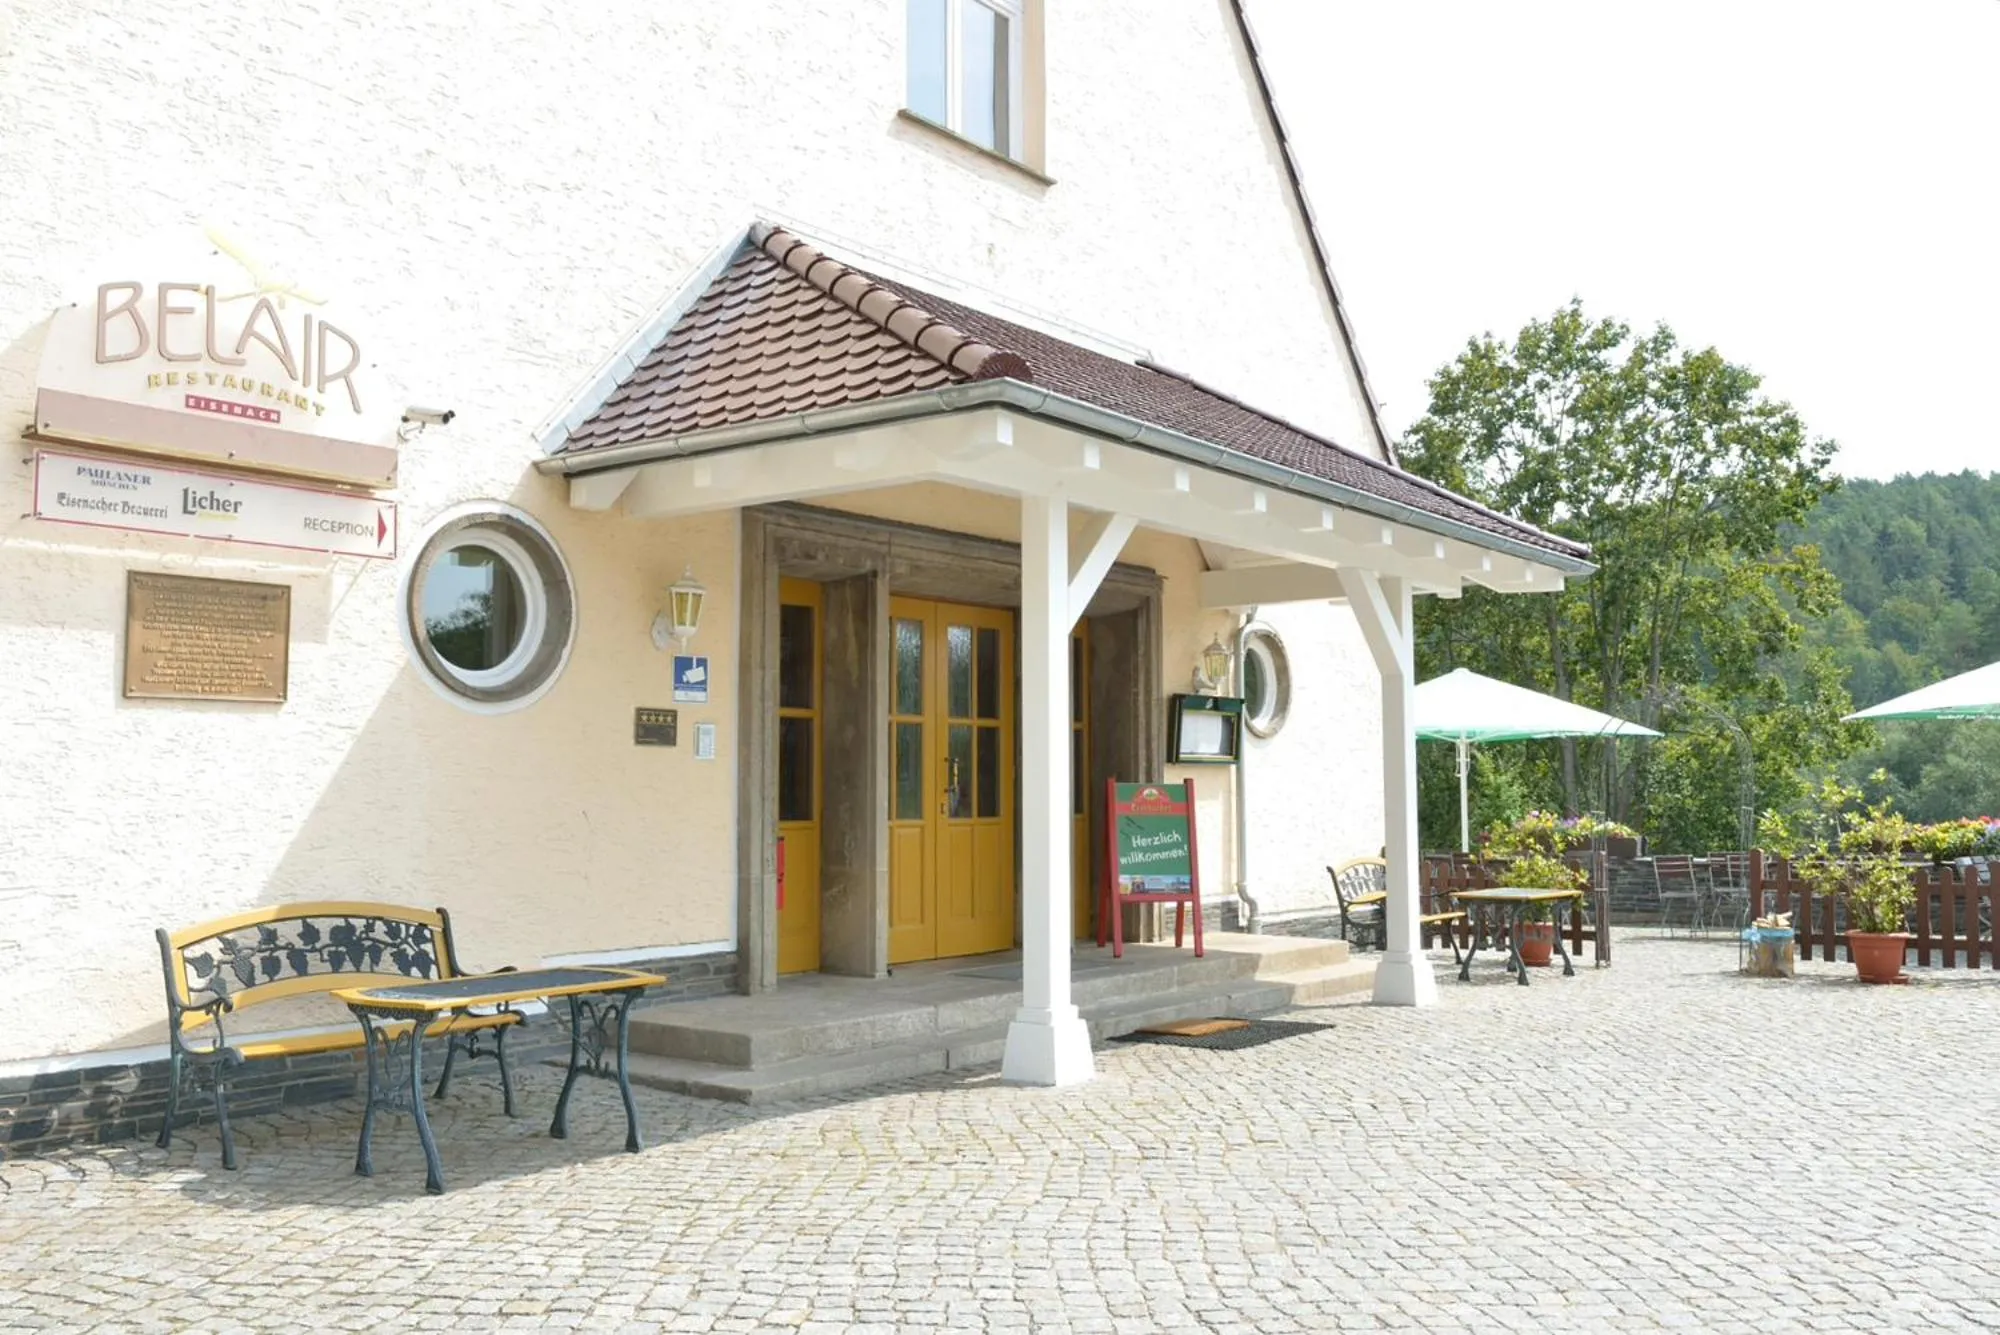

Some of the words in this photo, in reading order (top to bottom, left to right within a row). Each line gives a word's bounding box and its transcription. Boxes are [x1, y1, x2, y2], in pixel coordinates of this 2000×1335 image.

[147, 371, 326, 417] RESTAURANT
[187, 397, 280, 423] EISENACH
[76, 465, 152, 486] PAULANER
[181, 486, 243, 516] Licher
[303, 516, 375, 537] RECEPTION
[1131, 830, 1181, 848] Herzlich
